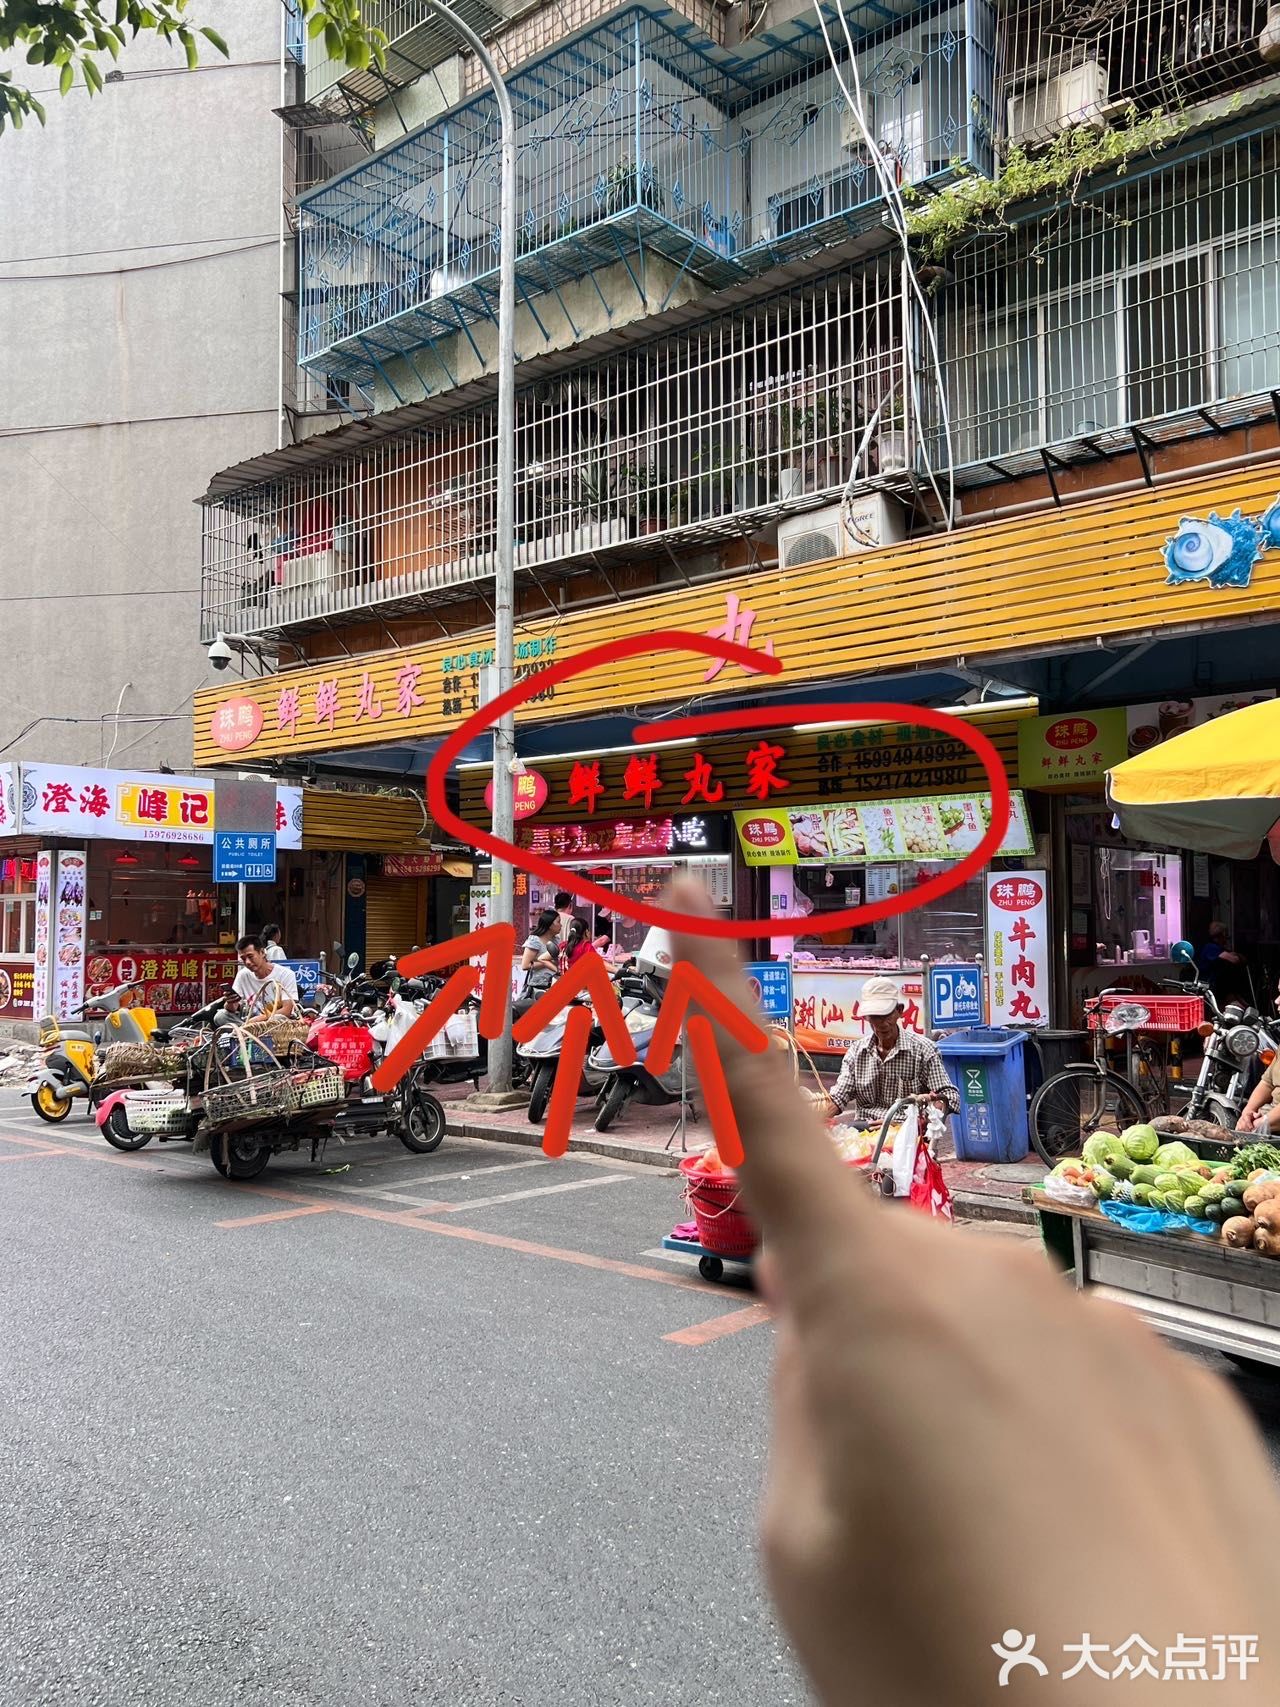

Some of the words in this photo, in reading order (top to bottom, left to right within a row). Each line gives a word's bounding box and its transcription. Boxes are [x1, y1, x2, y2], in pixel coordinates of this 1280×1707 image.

[514, 636, 557, 659] 场制作
[704, 592, 775, 682] 丸
[276, 660, 425, 738] 鲜鲜丸家
[219, 704, 254, 730] 珠鹏
[219, 734, 234, 743] ZHU
[235, 731, 253, 741] PENG
[1054, 722, 1089, 738] 珠鹏
[1041, 752, 1102, 768] 鲜鲜丸家
[517, 776, 536, 798] 鹏
[568, 741, 791, 814] 鲜鲜丸家
[515, 801, 535, 811] PENG
[143, 830, 204, 841] 15976928686
[747, 822, 778, 836] 珠鹏
[221, 837, 271, 850] 公共厕所
[512, 873, 527, 895] 惠
[996, 883, 1036, 899] 珠鹏
[1008, 917, 1041, 1019] 牛肉丸
[936, 977, 951, 1016] P
[794, 996, 924, 1035] 潮汕牛丸
